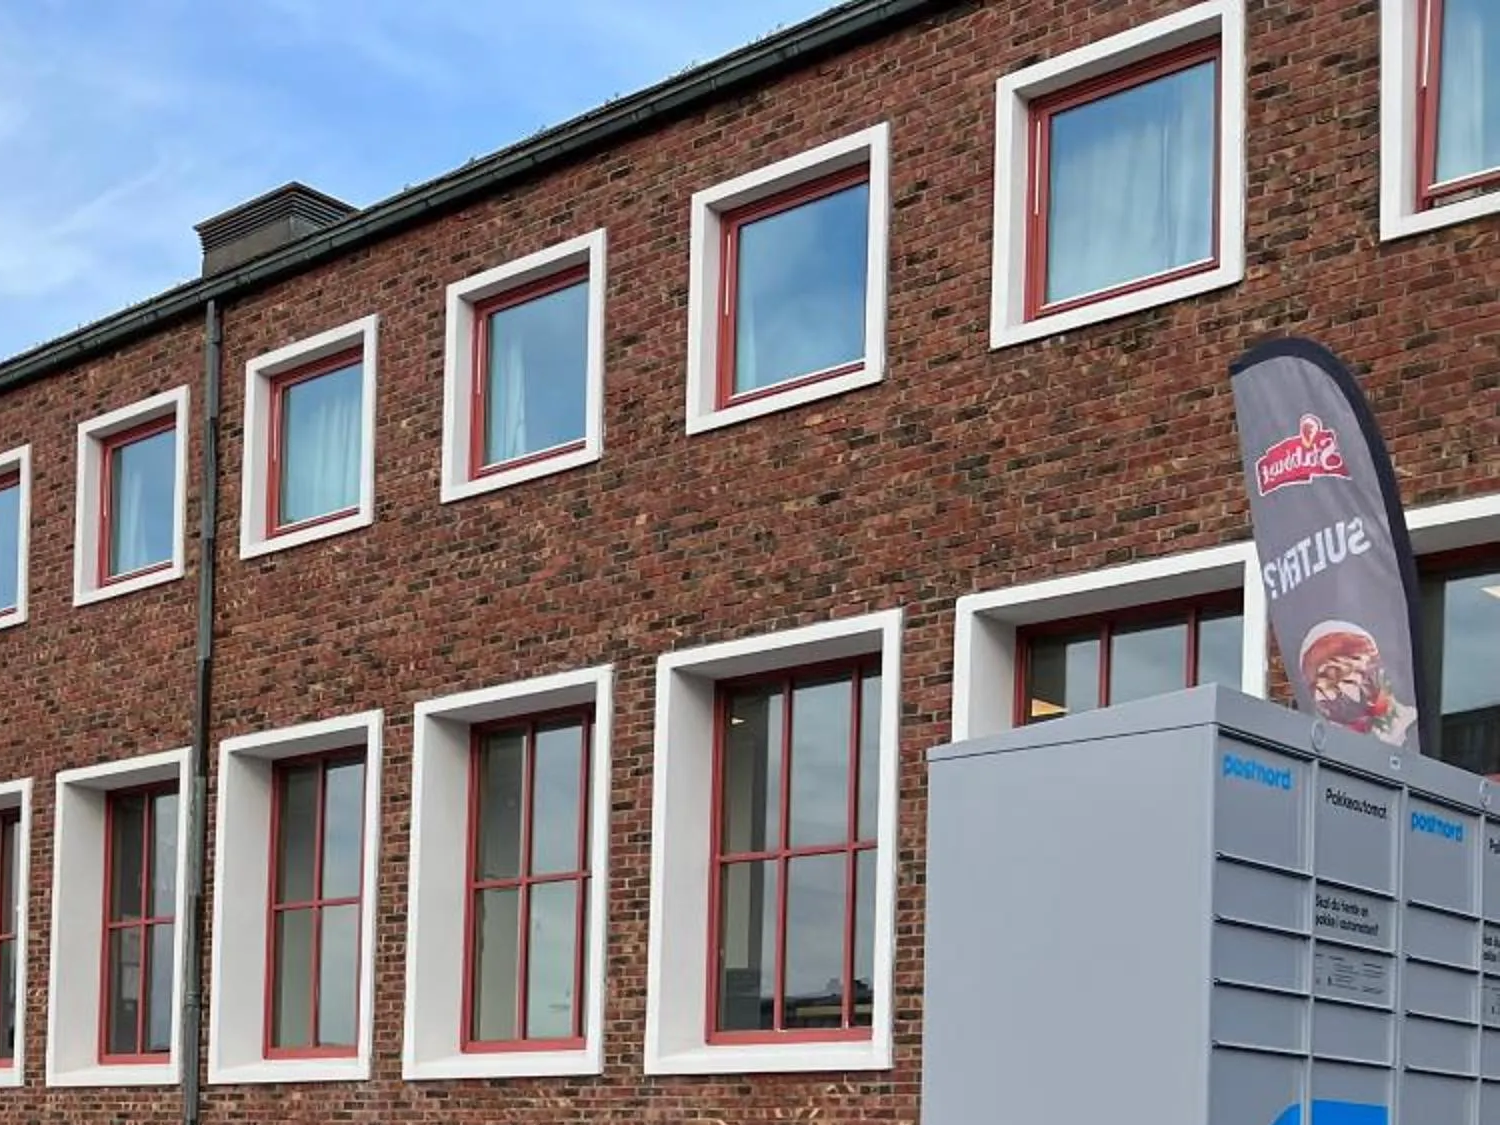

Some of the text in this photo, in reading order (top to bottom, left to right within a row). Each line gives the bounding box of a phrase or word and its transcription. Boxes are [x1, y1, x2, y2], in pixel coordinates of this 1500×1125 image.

[1222, 754, 1292, 790] postnord
[1325, 788, 1387, 819] Pakkeautomat
[1411, 811, 1464, 843] postnord
